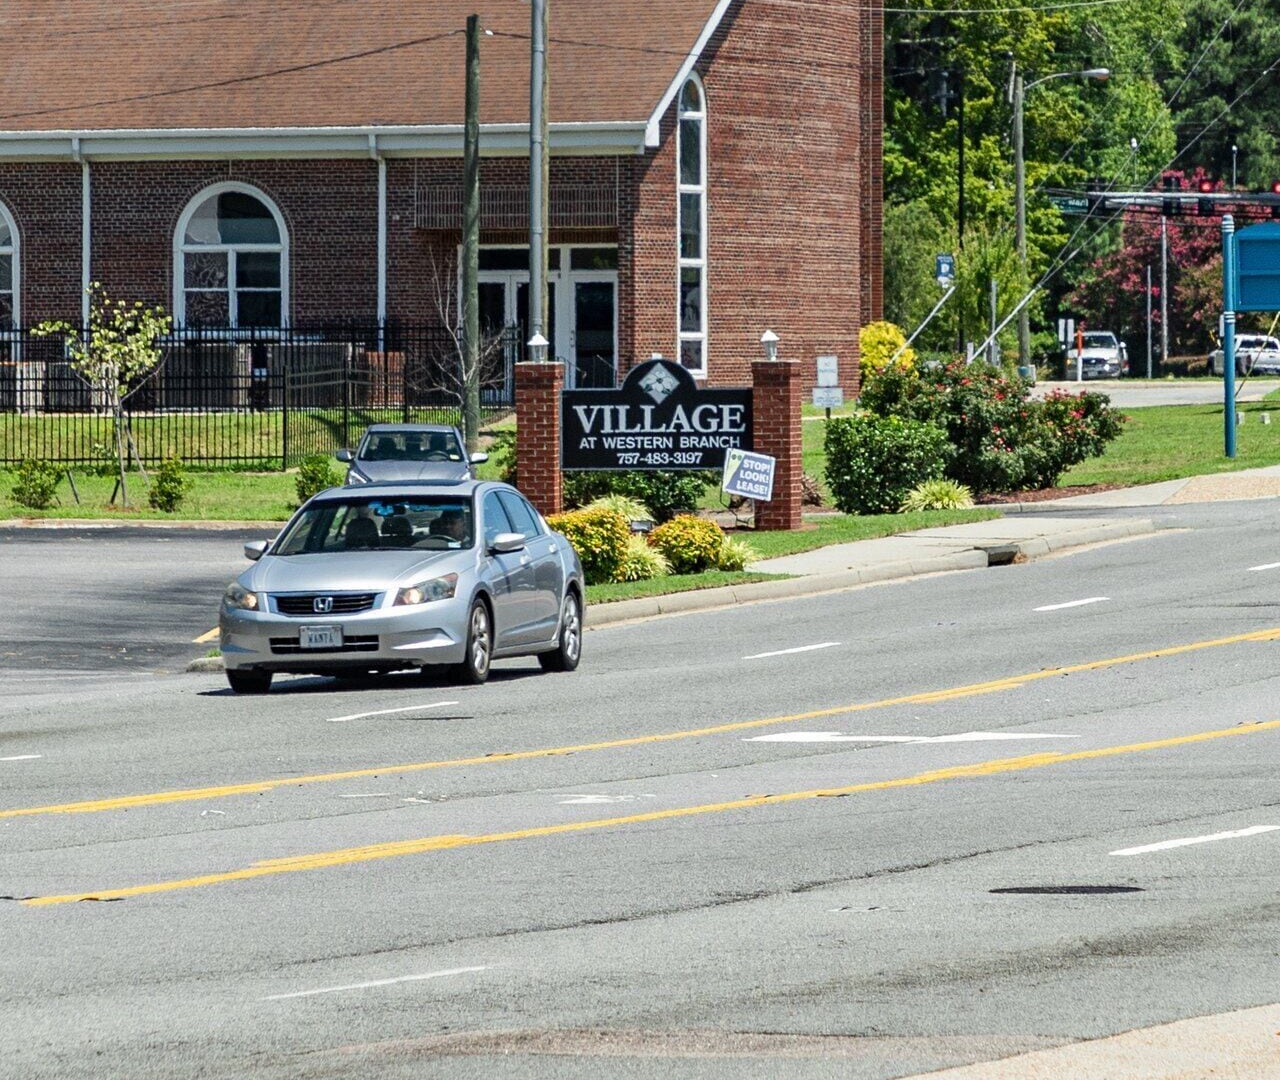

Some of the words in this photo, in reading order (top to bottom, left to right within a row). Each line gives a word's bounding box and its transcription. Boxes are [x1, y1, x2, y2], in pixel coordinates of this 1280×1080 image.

[572, 404, 746, 433] VILLAGE
[579, 437, 597, 449] AT
[602, 436, 673, 449] WESTERN
[680, 436, 740, 449] BRANCH
[617, 452, 703, 465] 757-483-3197
[743, 458, 770, 473] STOP!
[740, 470, 769, 483] LOOK!
[736, 480, 768, 495] LEASE!
